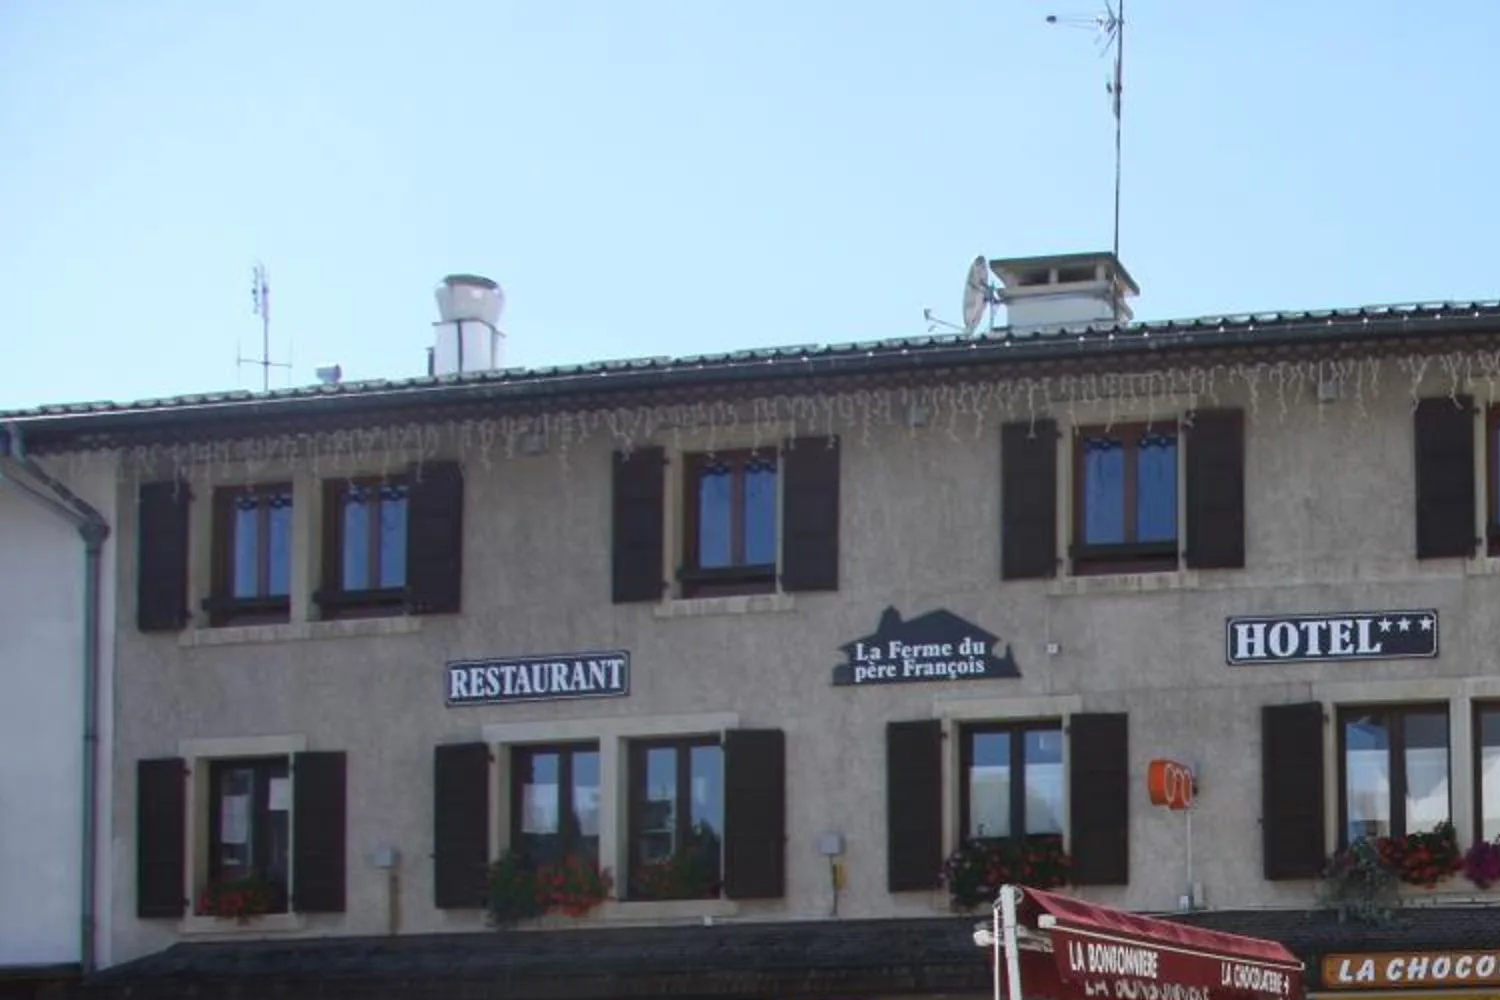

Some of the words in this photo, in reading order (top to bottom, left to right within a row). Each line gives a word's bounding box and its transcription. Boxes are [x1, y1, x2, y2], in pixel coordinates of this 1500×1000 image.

[855, 643, 880, 661] La
[890, 640, 954, 660] Ferme
[958, 637, 987, 656] du
[1234, 618, 1383, 659] HOTEL
[449, 657, 626, 700] RESTAURANT
[854, 661, 899, 683] père
[902, 657, 987, 682] François
[1068, 940, 1086, 972] LA
[1221, 961, 1232, 986] LA
[1337, 958, 1376, 983] LA
